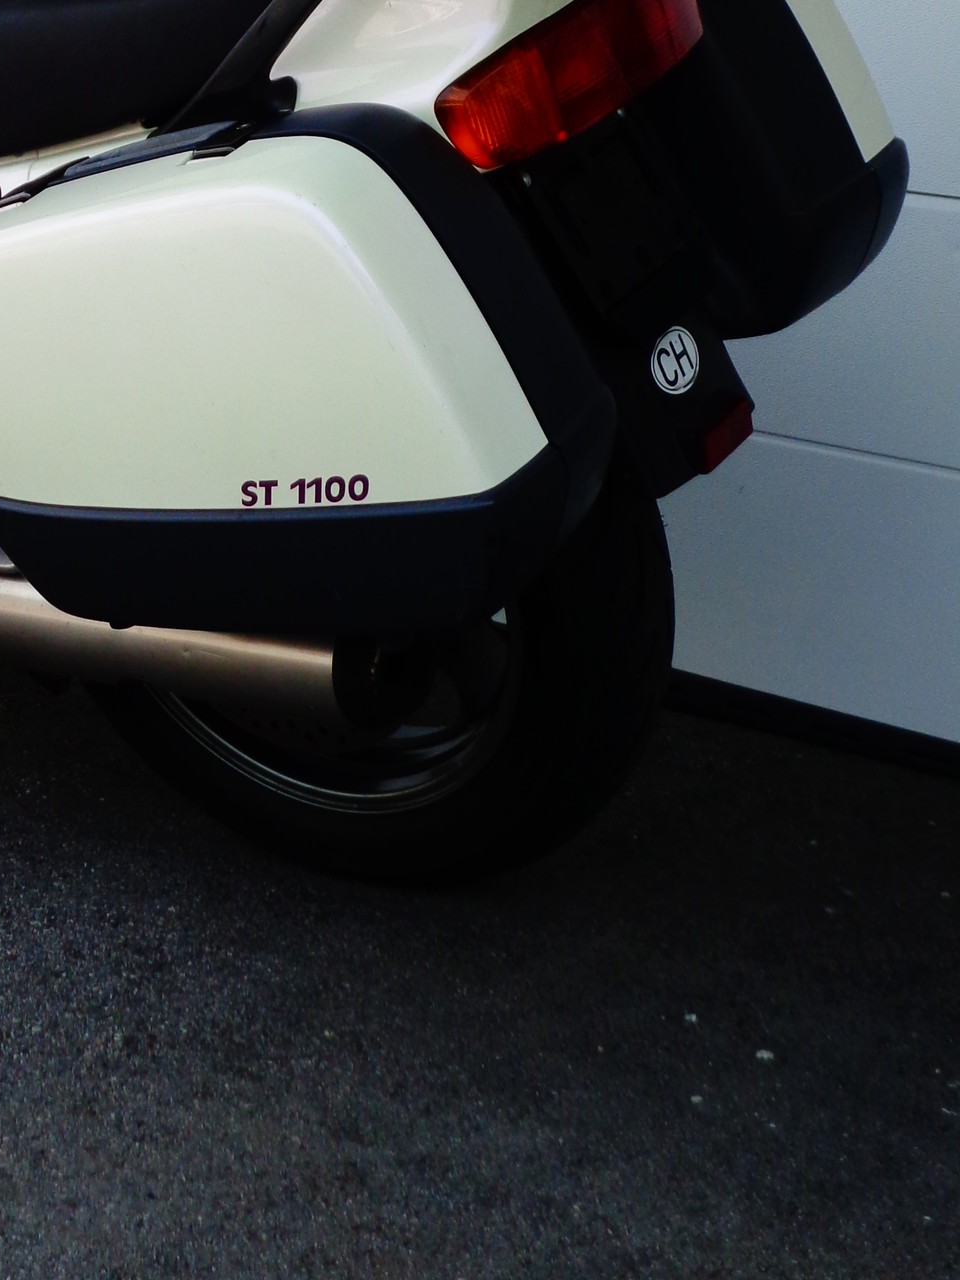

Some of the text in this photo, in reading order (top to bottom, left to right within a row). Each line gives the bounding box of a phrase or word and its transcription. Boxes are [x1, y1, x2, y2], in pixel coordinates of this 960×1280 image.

[657, 333, 694, 386] CH
[241, 474, 369, 507] ST 1100
